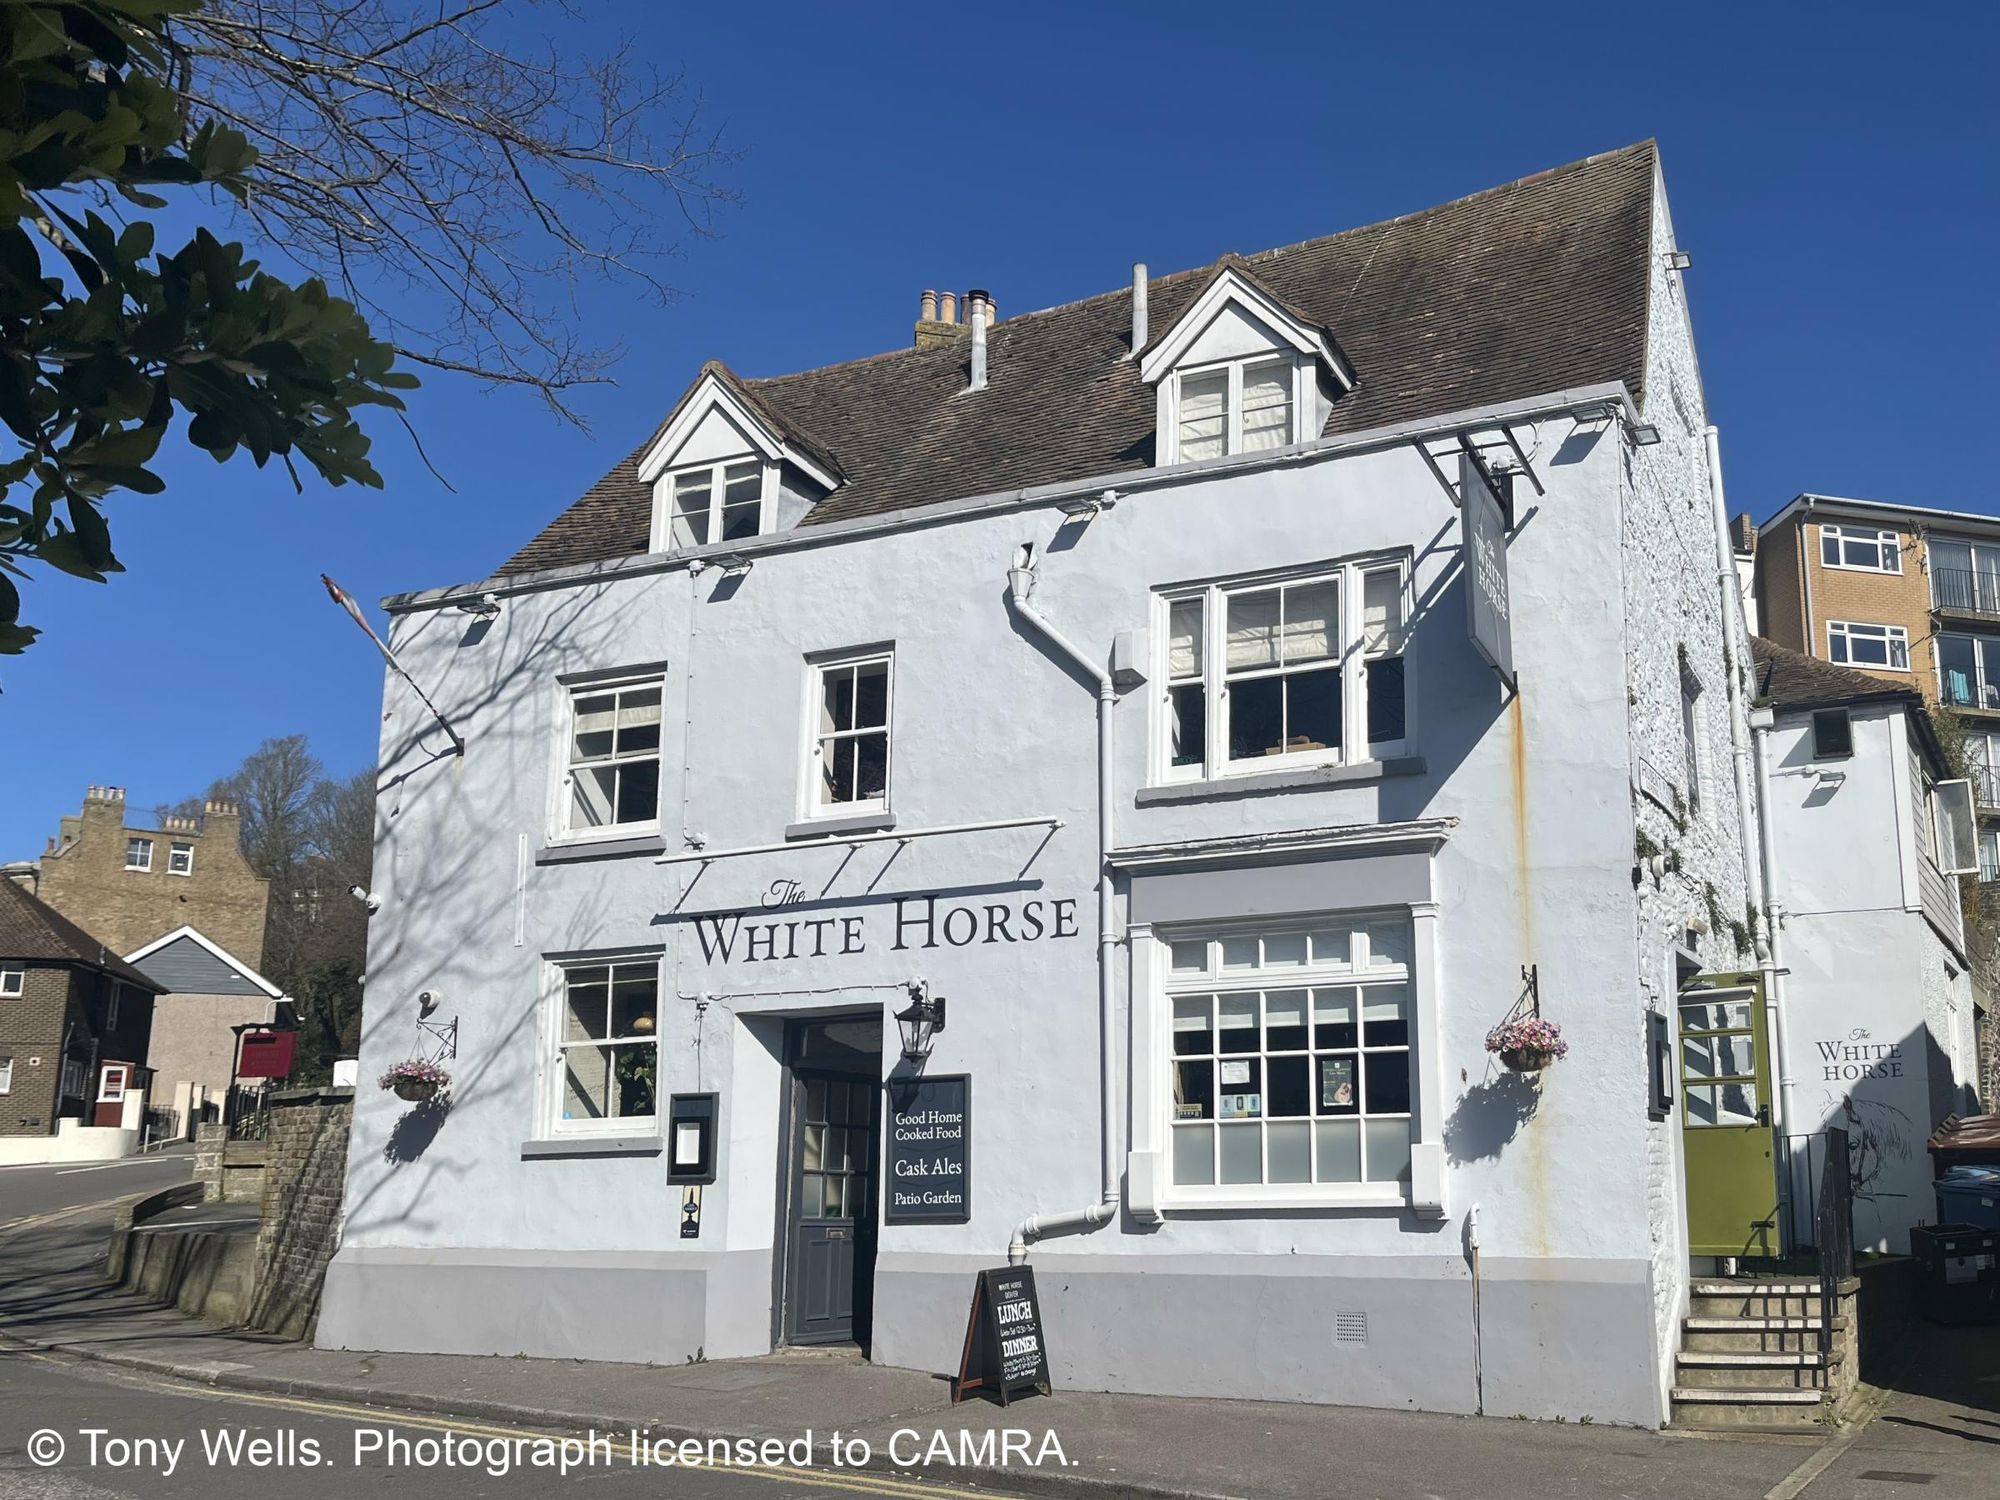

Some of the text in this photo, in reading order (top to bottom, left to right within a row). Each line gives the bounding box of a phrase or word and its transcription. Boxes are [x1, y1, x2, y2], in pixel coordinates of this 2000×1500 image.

[1474, 532, 1506, 598] WHITE
[1478, 566, 1507, 621] HORSE
[761, 879, 805, 910] The
[689, 894, 1080, 967] WHITE HORSE
[1848, 1028, 1871, 1041] The
[1815, 1040, 1902, 1062] WHITE
[1823, 1062, 1904, 1081] HORSE
[895, 1110, 963, 1126] Good Home
[895, 1125, 962, 1141] Cooked Food
[895, 1157, 962, 1177] Cask Ales
[894, 1190, 962, 1206] Patio Garden
[997, 1300, 1033, 1325] LUNCH
[1001, 1335, 1039, 1358] DINNER
